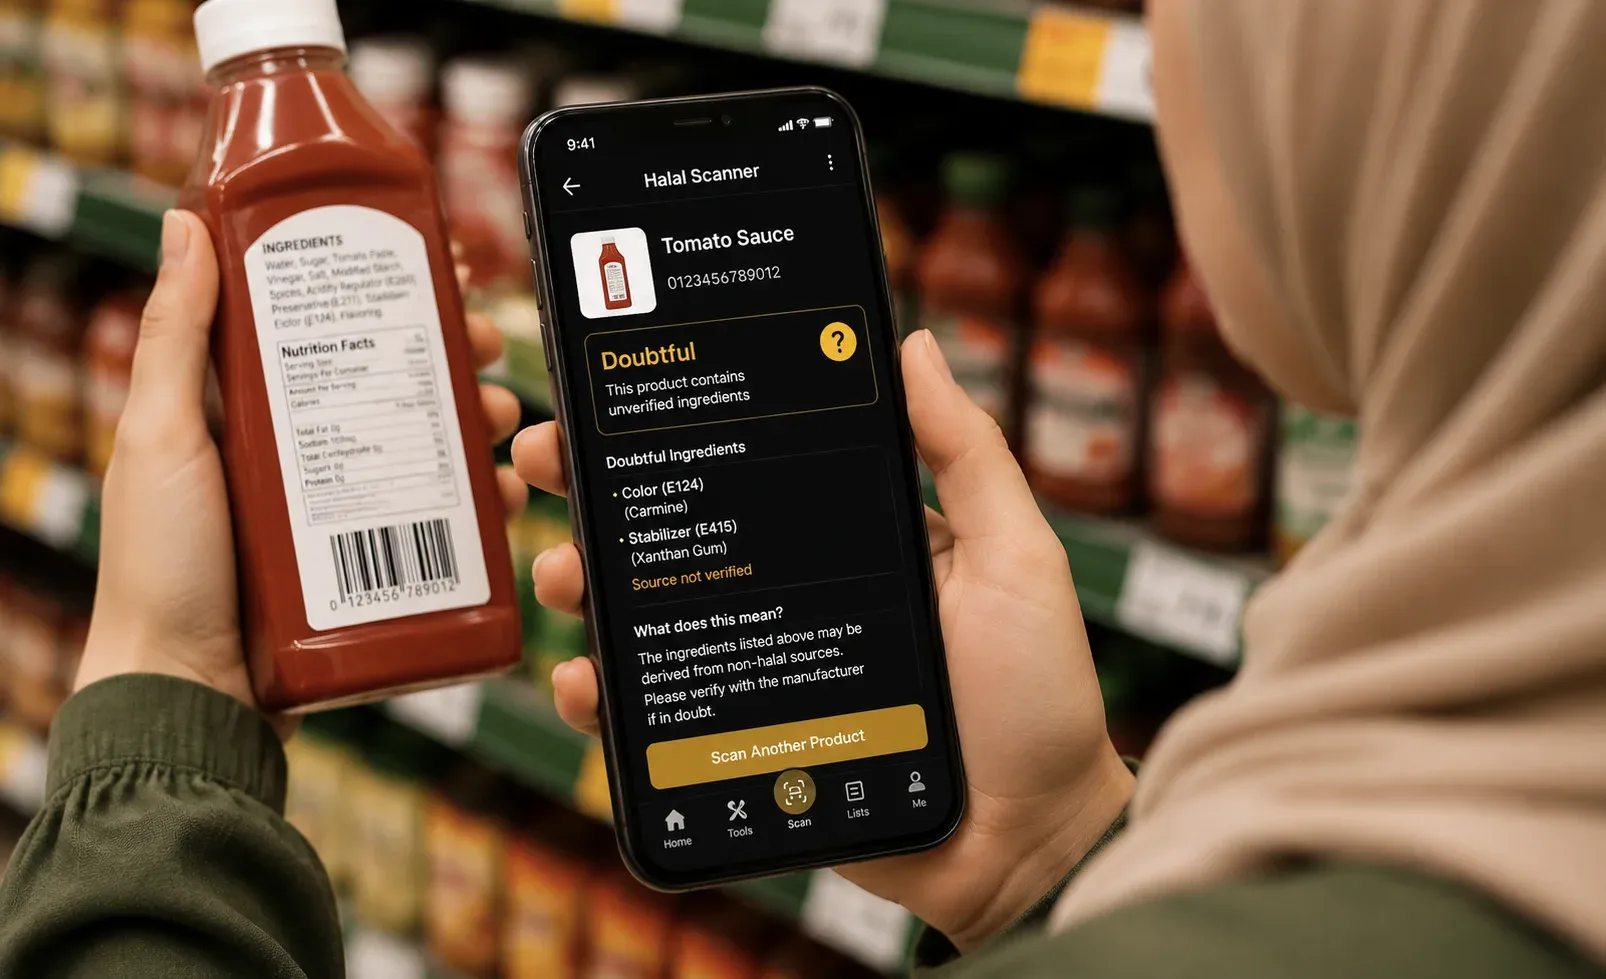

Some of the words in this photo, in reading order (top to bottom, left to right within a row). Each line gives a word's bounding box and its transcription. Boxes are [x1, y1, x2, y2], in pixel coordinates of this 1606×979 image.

[567, 137, 595, 151] 9:41
[644, 170, 687, 188] Halal
[691, 166, 759, 183] Scanner
[262, 235, 343, 254] INGREDIENTS
[661, 233, 732, 253] Tomato
[737, 229, 794, 246] Sauce
[668, 266, 781, 289] 0123456789012
[281, 341, 338, 358] Nutrition
[341, 337, 376, 351] Facts
[601, 342, 696, 370] Doubtful
[605, 383, 633, 396] This
[637, 377, 688, 395] product
[691, 371, 745, 386] contains
[609, 397, 674, 416] unverified
[678, 391, 750, 409] ingredients
[606, 450, 666, 469] Doubtful
[670, 442, 746, 462] Ingredients
[622, 485, 658, 499] Color
[662, 477, 703, 496] (E124)
[625, 500, 687, 521] (Carmine)
[629, 528, 691, 544] Stabilizer
[695, 519, 737, 537] (E415)
[632, 548, 689, 567] (Xanthan
[693, 541, 727, 556] Gum)
[632, 577, 677, 590] Source
[681, 571, 702, 584] not
[705, 564, 752, 580] verified
[329, 599, 338, 612] 0
[348, 588, 400, 608] 123456
[407, 581, 456, 599] 789012
[634, 623, 671, 637] What
[674, 620, 707, 632] does
[710, 614, 735, 627] this
[739, 606, 783, 624] mean?
[638, 652, 662, 664] The
[666, 642, 736, 661] ingredients
[740, 634, 773, 650] listed
[777, 631, 814, 644] above
[818, 627, 843, 639] may
[846, 624, 862, 635] be
[642, 666, 690, 684] derived
[693, 665, 723, 676] from
[728, 652, 787, 672] non-halal
[790, 648, 843, 662] sources.
[644, 692, 686, 706] Please
[690, 683, 725, 698] verify
[728, 679, 755, 693] with
[758, 676, 778, 688] the
[783, 665, 864, 685] manufacturer
[648, 713, 656, 725] if
[659, 712, 671, 723] in
[675, 706, 715, 721] doubt.
[711, 750, 746, 764] Scan
[751, 741, 806, 758] Another
[810, 730, 865, 748] Product
[847, 808, 869, 818] Lists
[913, 799, 926, 808] Me
[728, 826, 753, 837] Tools
[788, 819, 811, 829] Scan
[664, 838, 692, 848] Home
